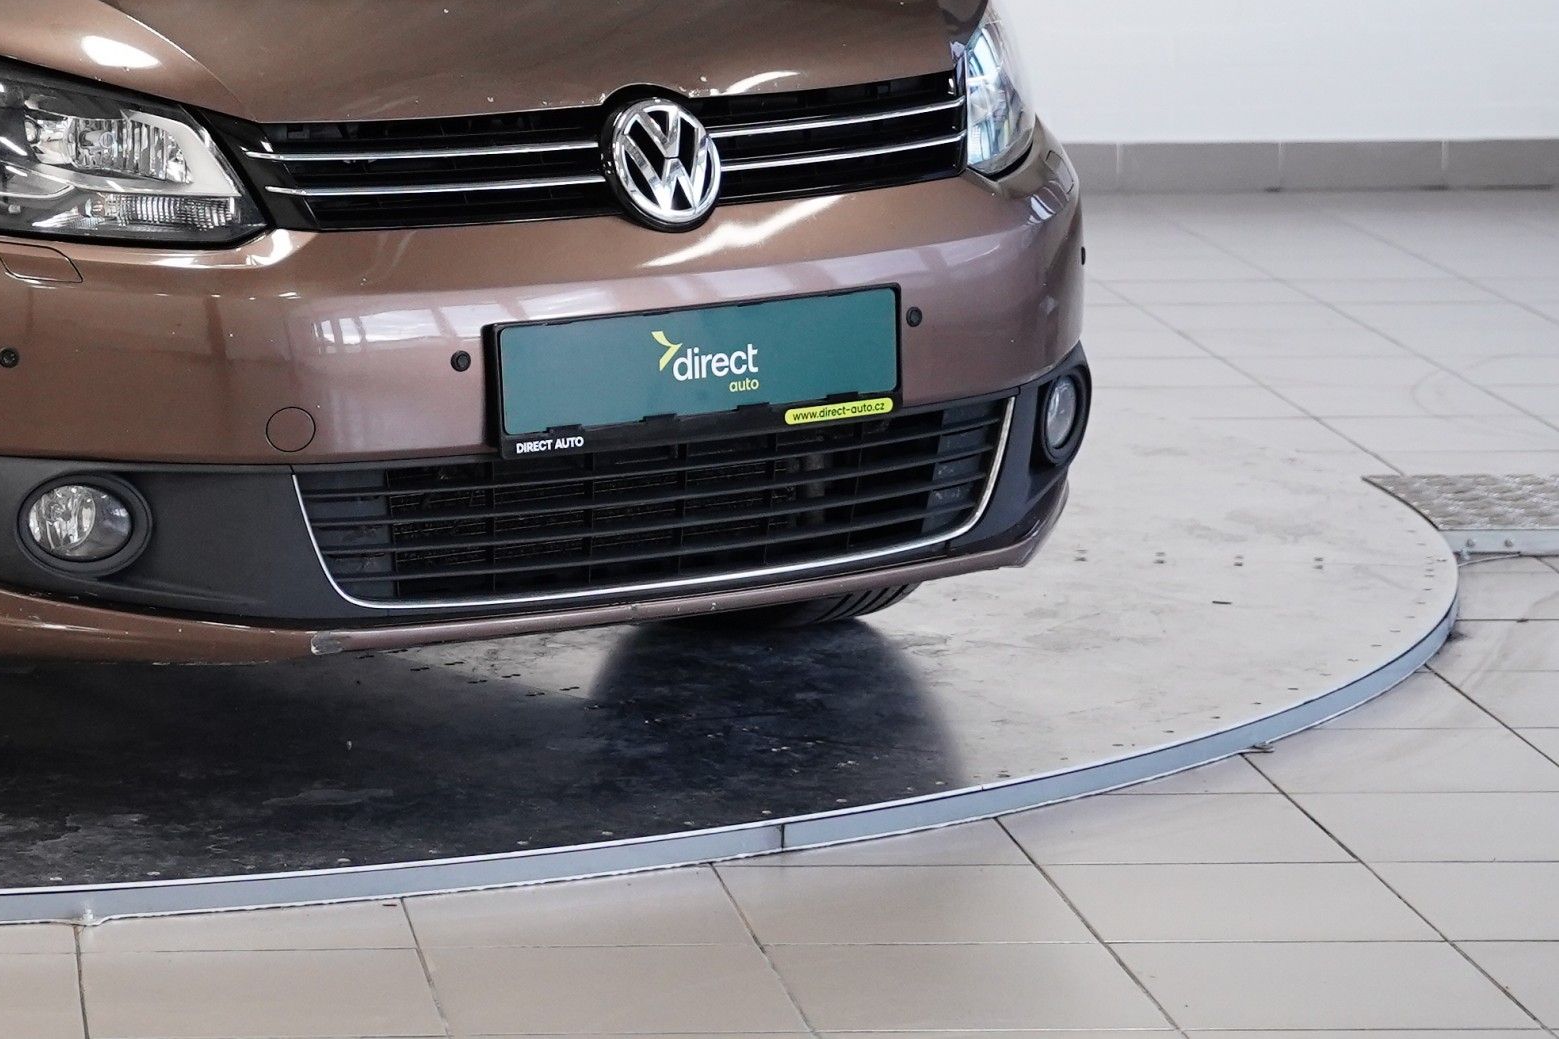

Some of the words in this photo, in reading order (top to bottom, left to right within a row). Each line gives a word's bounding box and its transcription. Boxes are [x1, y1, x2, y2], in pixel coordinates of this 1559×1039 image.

[614, 99, 720, 221] VW
[673, 344, 759, 381] direct
[729, 378, 760, 393] auto
[792, 402, 885, 421] www.direct-auto.cz
[516, 439, 553, 454] DIRECT
[554, 436, 585, 450] AUTO
